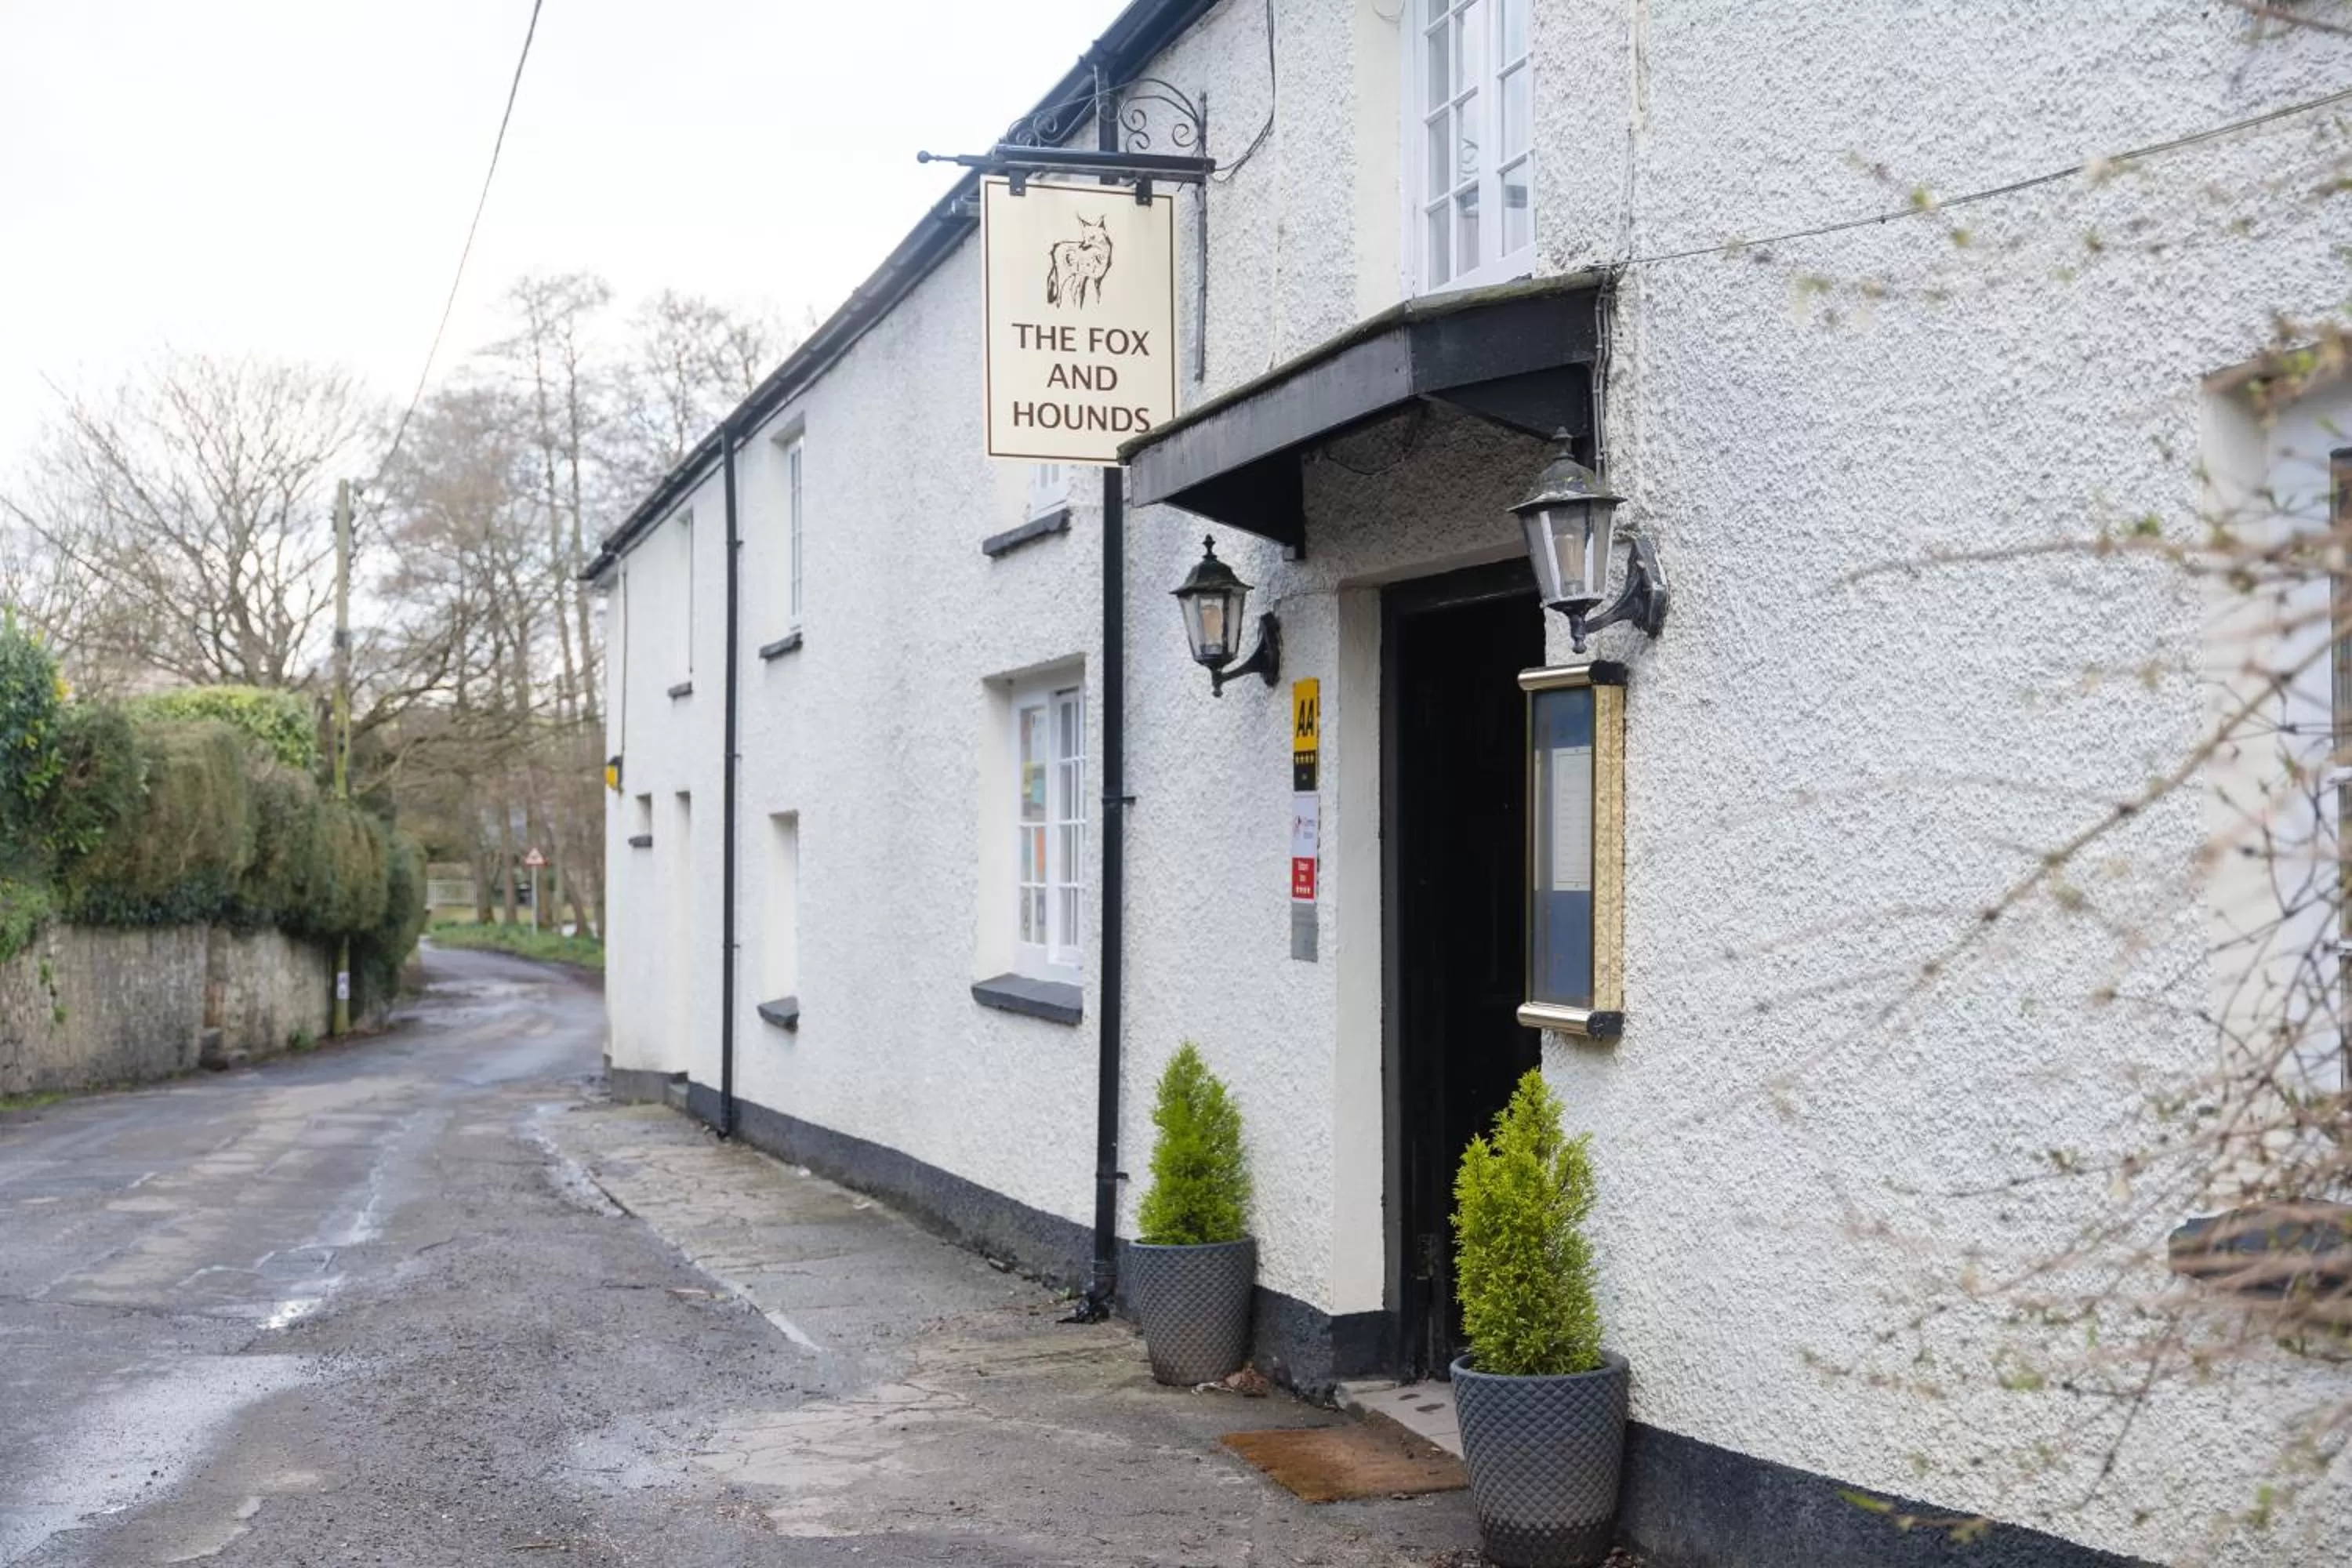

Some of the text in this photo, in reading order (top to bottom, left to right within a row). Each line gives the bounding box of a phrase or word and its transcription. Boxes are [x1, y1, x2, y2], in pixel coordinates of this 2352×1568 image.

[1011, 323, 1150, 356] THE FOX
[1047, 364, 1118, 391] AND
[1014, 401, 1151, 434] HOUNDS
[1297, 699, 1314, 738] AA
